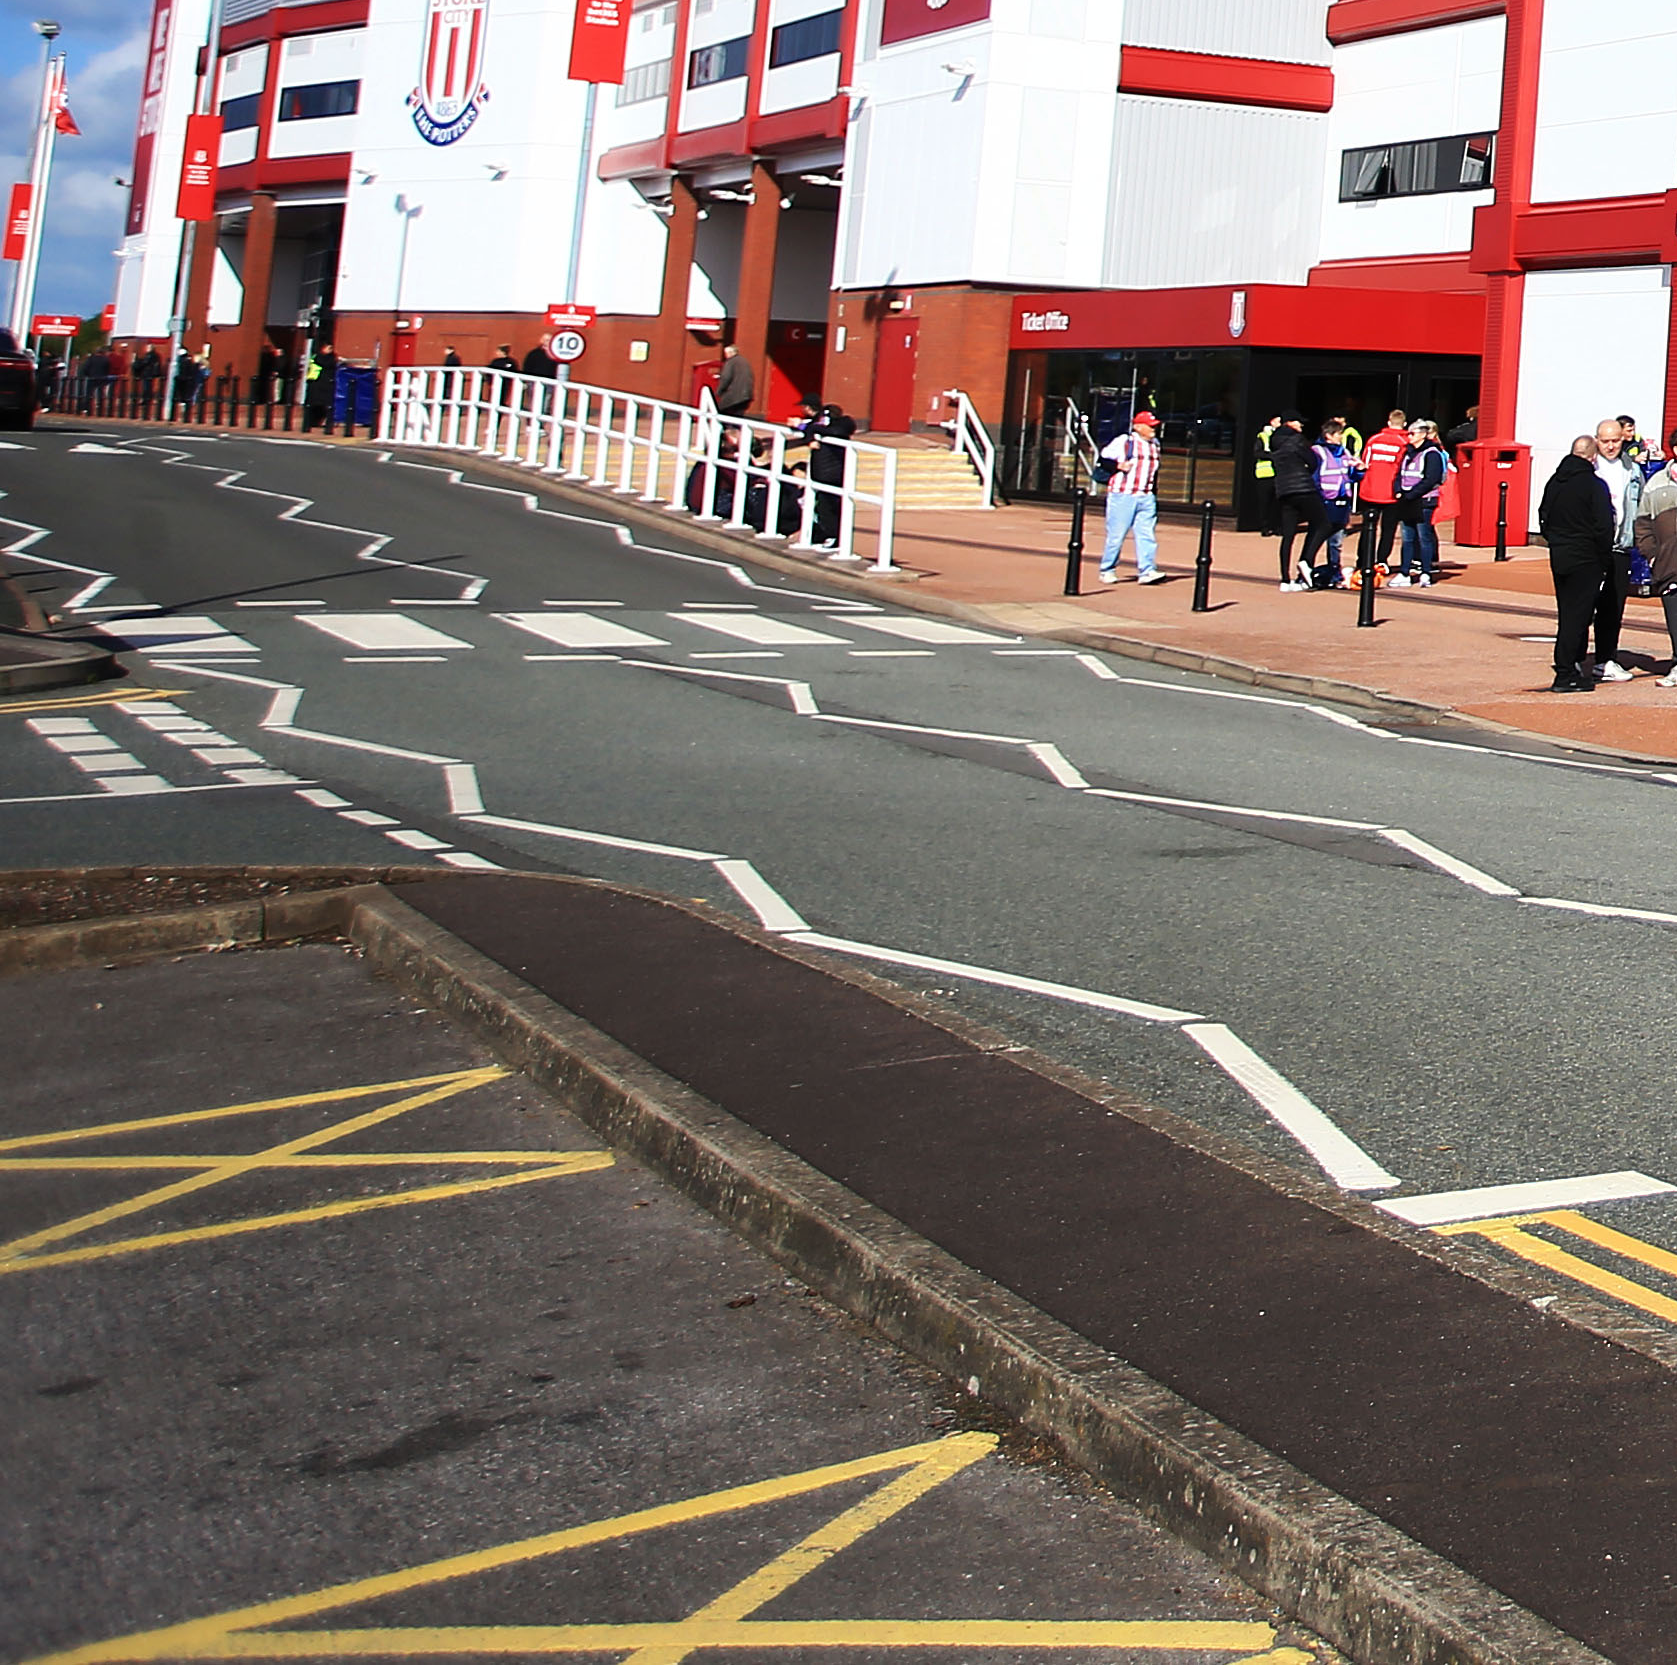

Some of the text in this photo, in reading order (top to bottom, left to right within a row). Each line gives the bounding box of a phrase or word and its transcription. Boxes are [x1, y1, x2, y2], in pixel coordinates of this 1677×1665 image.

[444, 9, 470, 24] CITY
[432, 106, 477, 144] POTTERS
[1022, 310, 1069, 331] Ticket Office
[558, 337, 579, 350] 10
